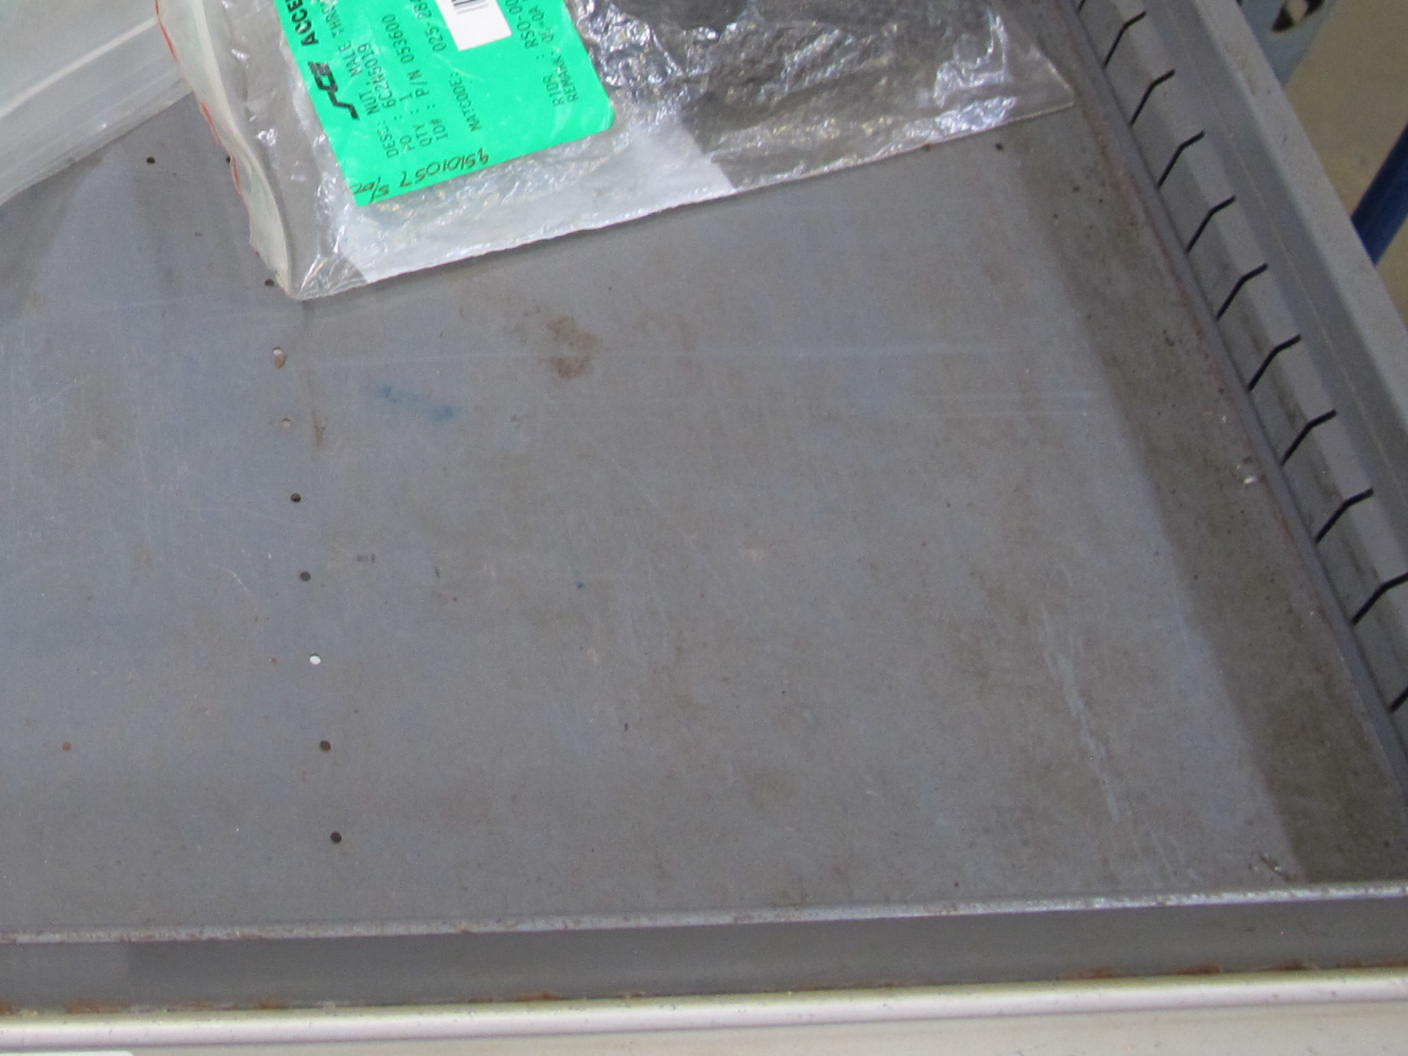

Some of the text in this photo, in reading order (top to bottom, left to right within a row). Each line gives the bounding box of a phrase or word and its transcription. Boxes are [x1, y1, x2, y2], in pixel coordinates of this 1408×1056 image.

[380, 11, 416, 65] 053600
[404, 68, 431, 97] P/N
[411, 120, 434, 148] QTY
